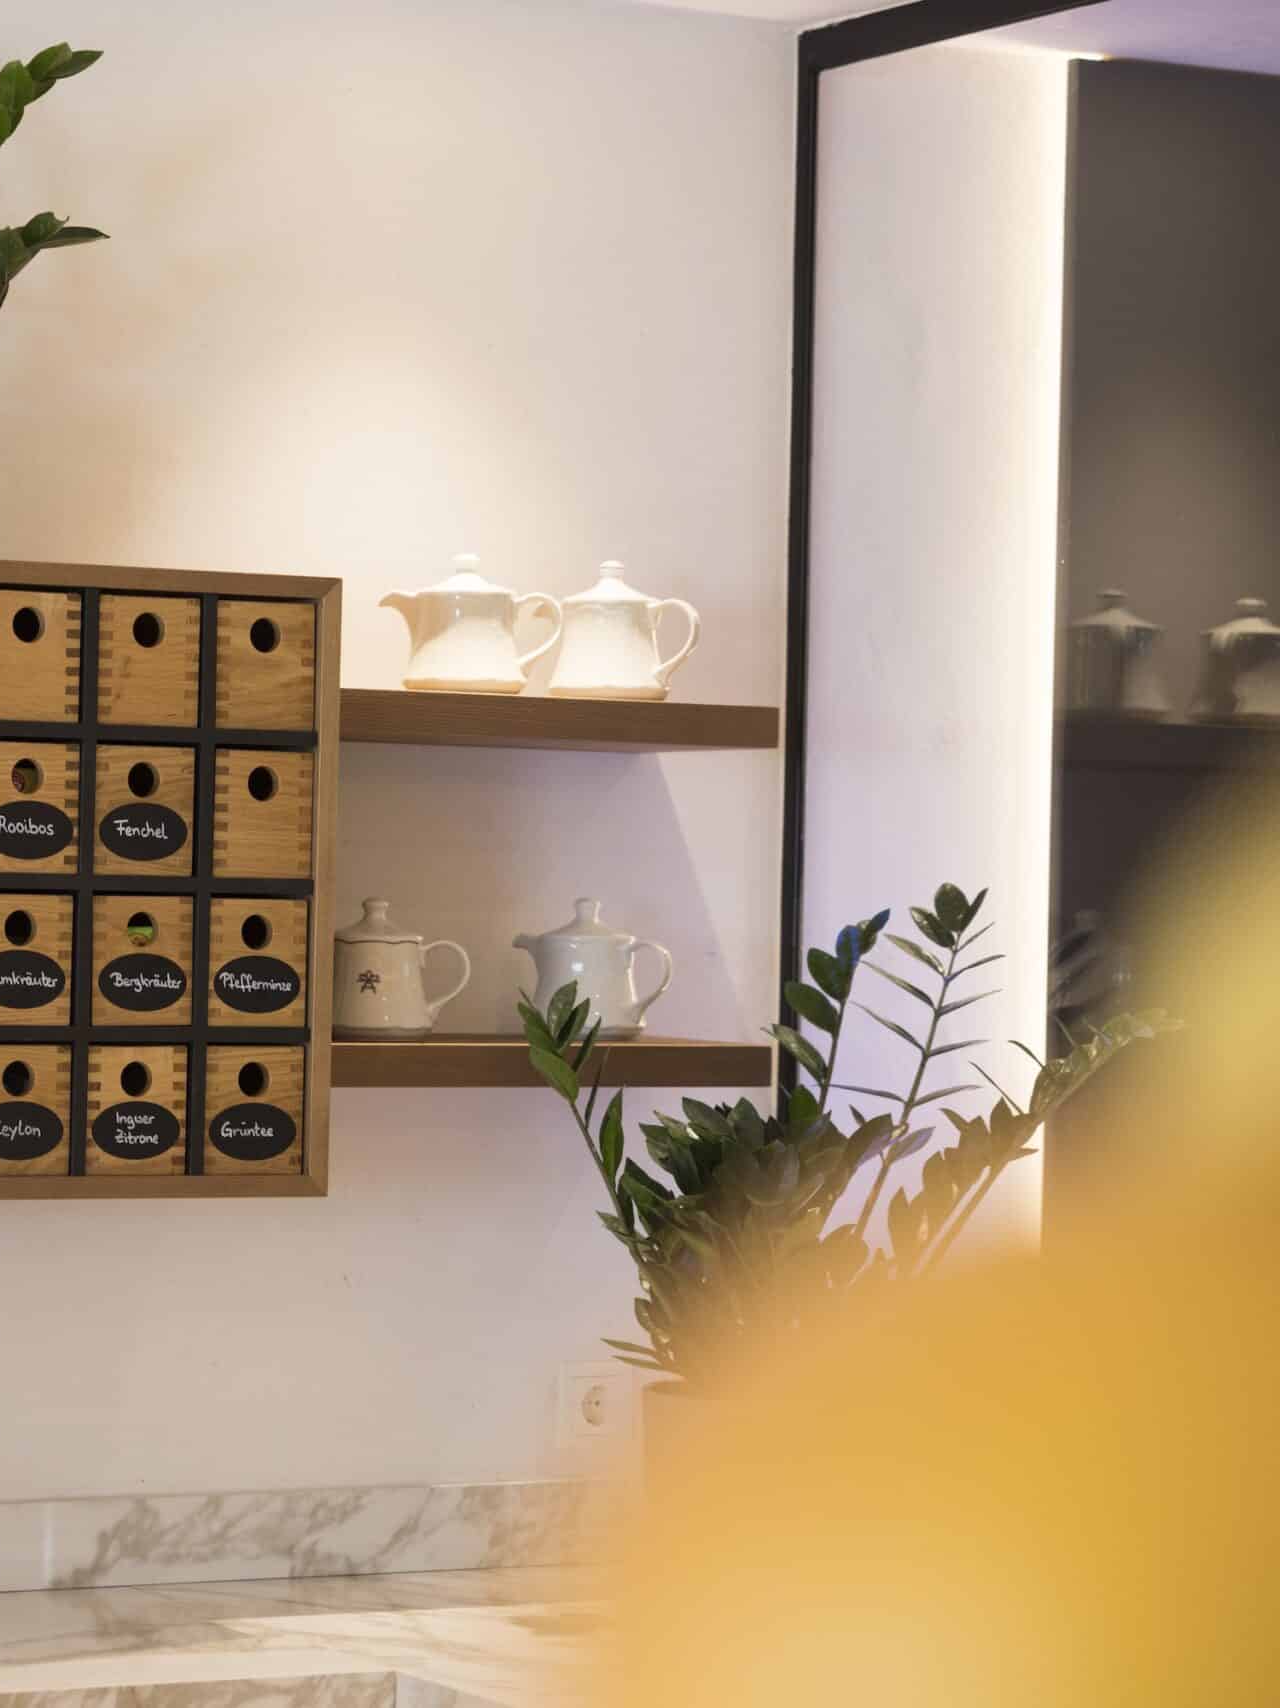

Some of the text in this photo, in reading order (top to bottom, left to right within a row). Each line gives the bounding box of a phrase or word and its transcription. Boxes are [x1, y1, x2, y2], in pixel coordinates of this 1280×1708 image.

[113, 819, 168, 839] Fenchel
[109, 971, 183, 992] Bergkräuter
[220, 972, 292, 992] Pfefferminze
[114, 1129, 159, 1145] Zitrone
[220, 1121, 274, 1138] Grüntee
